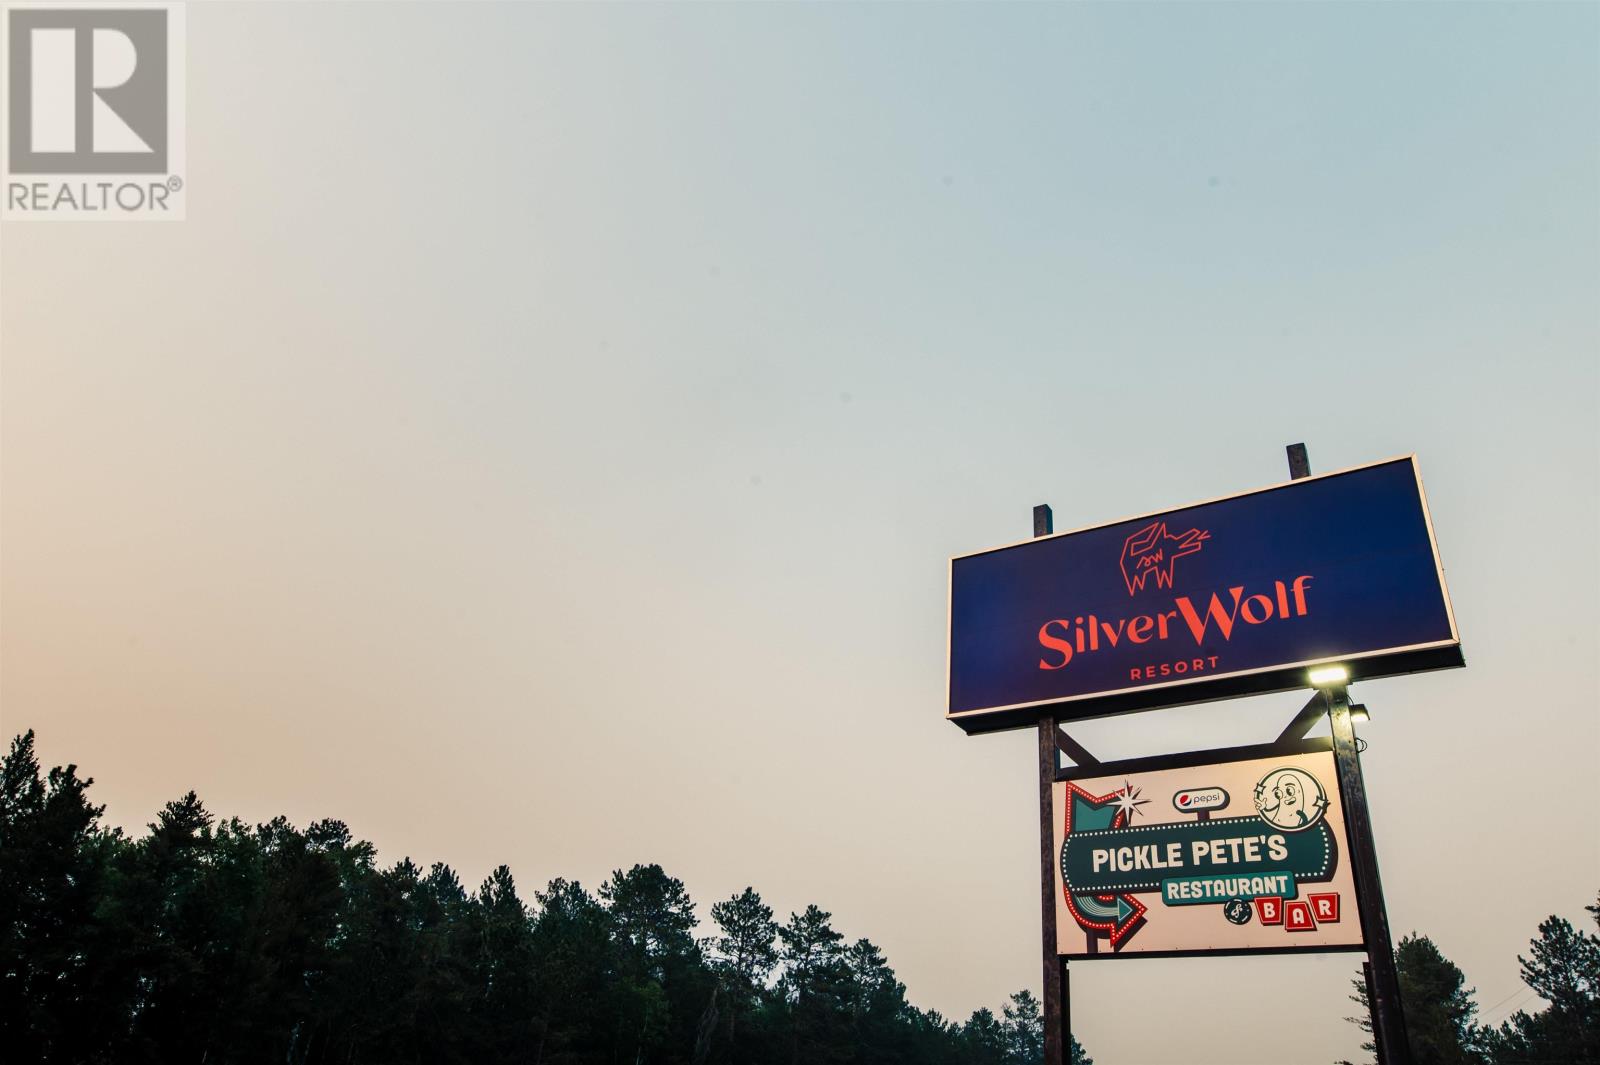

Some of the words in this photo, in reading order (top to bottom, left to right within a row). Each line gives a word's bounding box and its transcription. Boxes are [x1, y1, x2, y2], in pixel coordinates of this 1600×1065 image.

[1130, 656, 1219, 680] RESORT
[1193, 792, 1221, 805] pepsi
[1092, 842, 1183, 873] PICKLE
[1191, 834, 1289, 866] PETE'S
[1167, 875, 1289, 899] RESTAURANT
[1263, 898, 1332, 925] BAR
